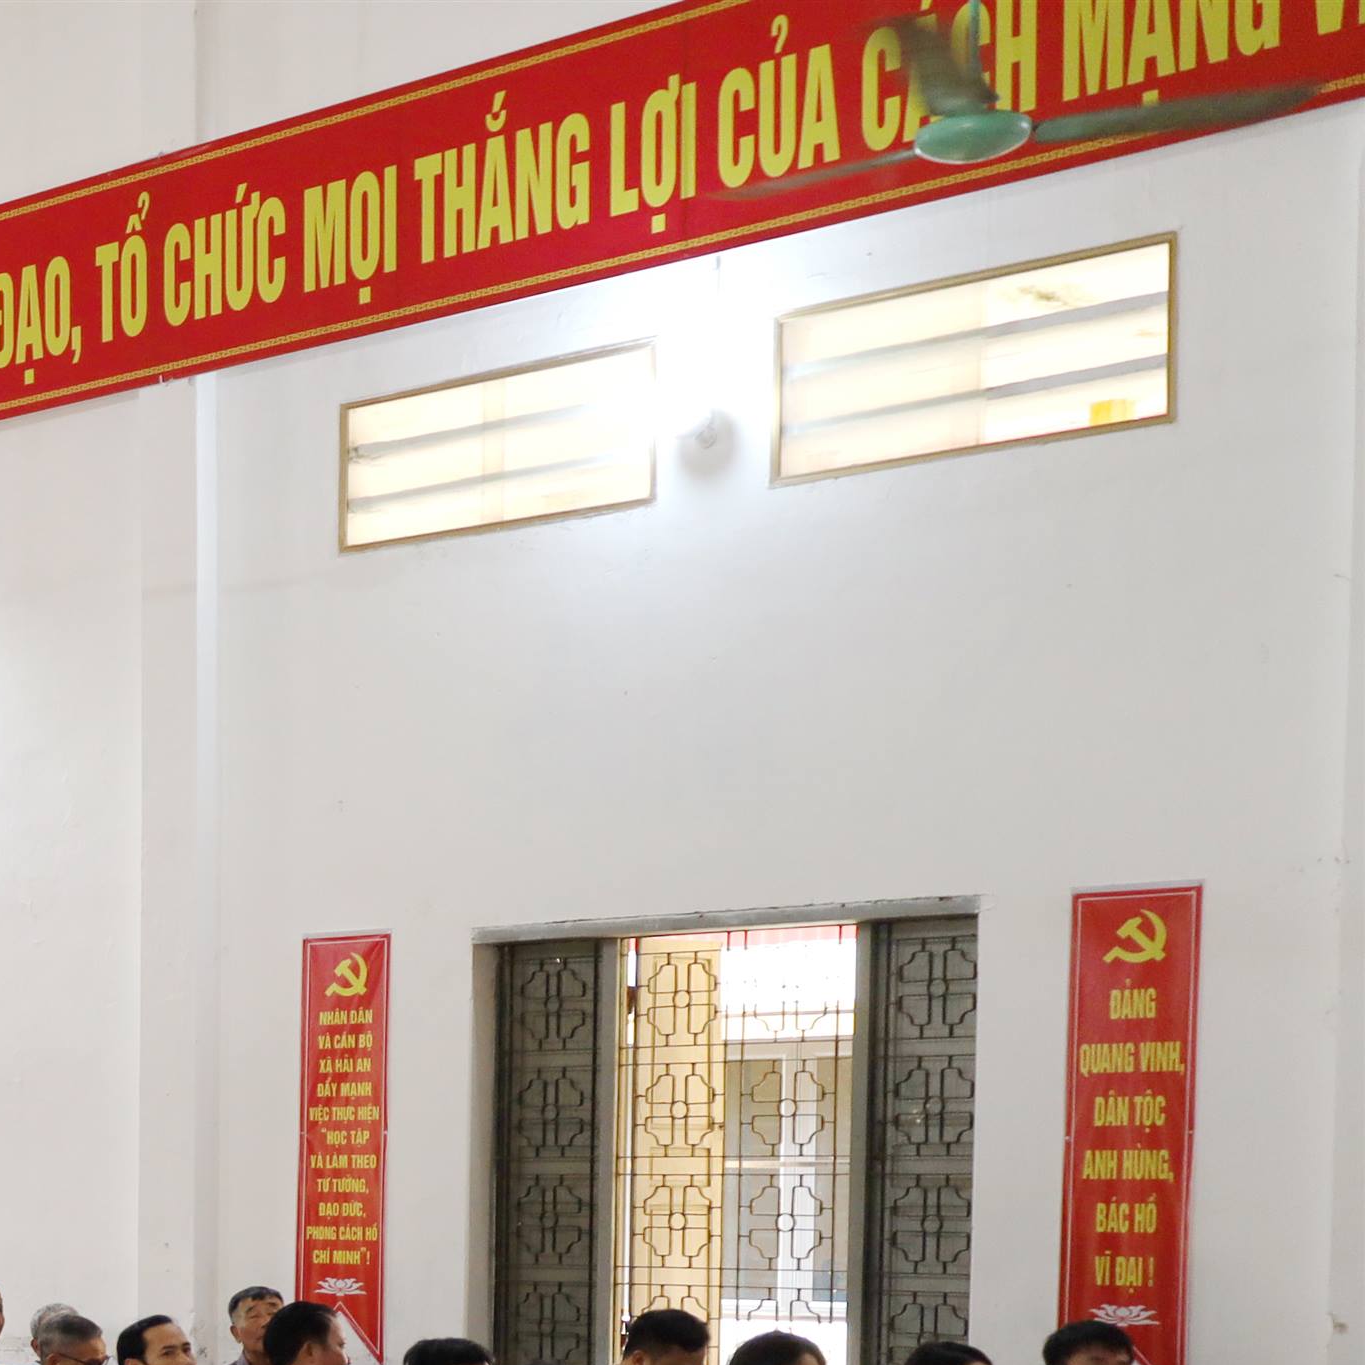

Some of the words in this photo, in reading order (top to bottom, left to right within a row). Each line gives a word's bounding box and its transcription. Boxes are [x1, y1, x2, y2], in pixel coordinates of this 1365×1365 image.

[95, 192, 150, 342] TỔ
[163, 184, 286, 326] CHỨC
[303, 164, 397, 303] MỌI
[414, 91, 590, 265] THẮNG
[610, 74, 696, 234] LỢI
[718, 15, 840, 189] CỦA
[1110, 978, 1157, 1020] ĐẢNG
[319, 1008, 348, 1025] NHÂN
[350, 1007, 373, 1025] DÂN
[318, 1032, 332, 1049] VÀ
[334, 1031, 356, 1048] CÁN
[359, 1030, 373, 1051] BỘ
[356, 1058, 372, 1072] AN
[1080, 1042, 1135, 1077] QUANG
[1140, 1041, 1185, 1075] VINH,
[341, 1081, 372, 1100] MẠNH
[309, 1104, 330, 1124] VIỆC
[1094, 1089, 1129, 1127] DÂN
[1134, 1089, 1166, 1133] TỘC
[350, 1128, 370, 1148] TẬP
[310, 1152, 324, 1169] VÀ
[326, 1152, 348, 1169] LÀM
[351, 1154, 377, 1169] THEO
[1082, 1149, 1118, 1179] ANH
[1122, 1142, 1175, 1183] HÙNG,
[1096, 1196, 1130, 1233] BÁC
[306, 1226, 337, 1240] PHONG
[339, 1224, 363, 1240] CÁCH
[313, 1248, 330, 1264] CHÍ
[1095, 1250, 1111, 1286] VĨ
[1115, 1256, 1143, 1293] ĐẠI
